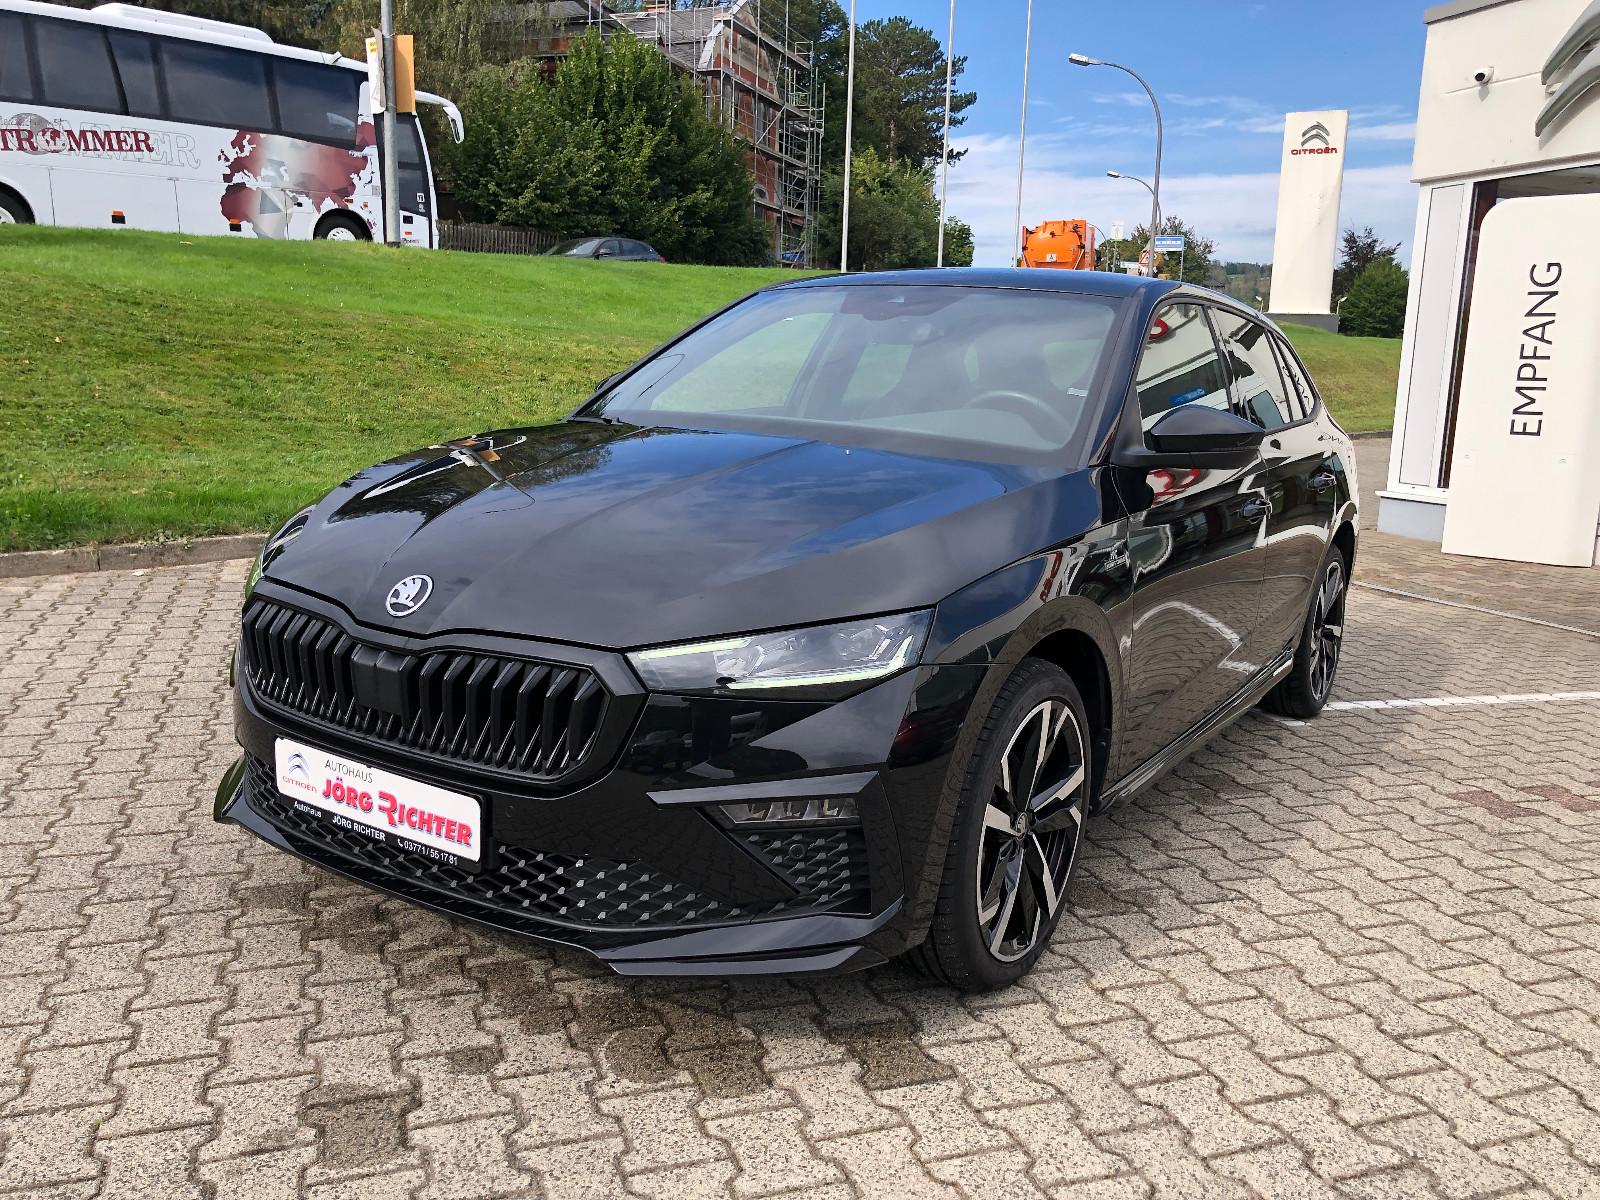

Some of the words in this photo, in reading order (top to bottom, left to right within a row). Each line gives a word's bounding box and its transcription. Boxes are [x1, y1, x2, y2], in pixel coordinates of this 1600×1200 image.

[1509, 262, 1563, 437] EMPFANG
[325, 759, 373, 784] AUTOHAUS
[294, 800, 322, 818] Autohaus
[322, 776, 374, 813] JÖRG
[378, 790, 473, 847] RICHTER
[332, 815, 352, 829] JÖRG
[353, 822, 386, 842] RICHTER
